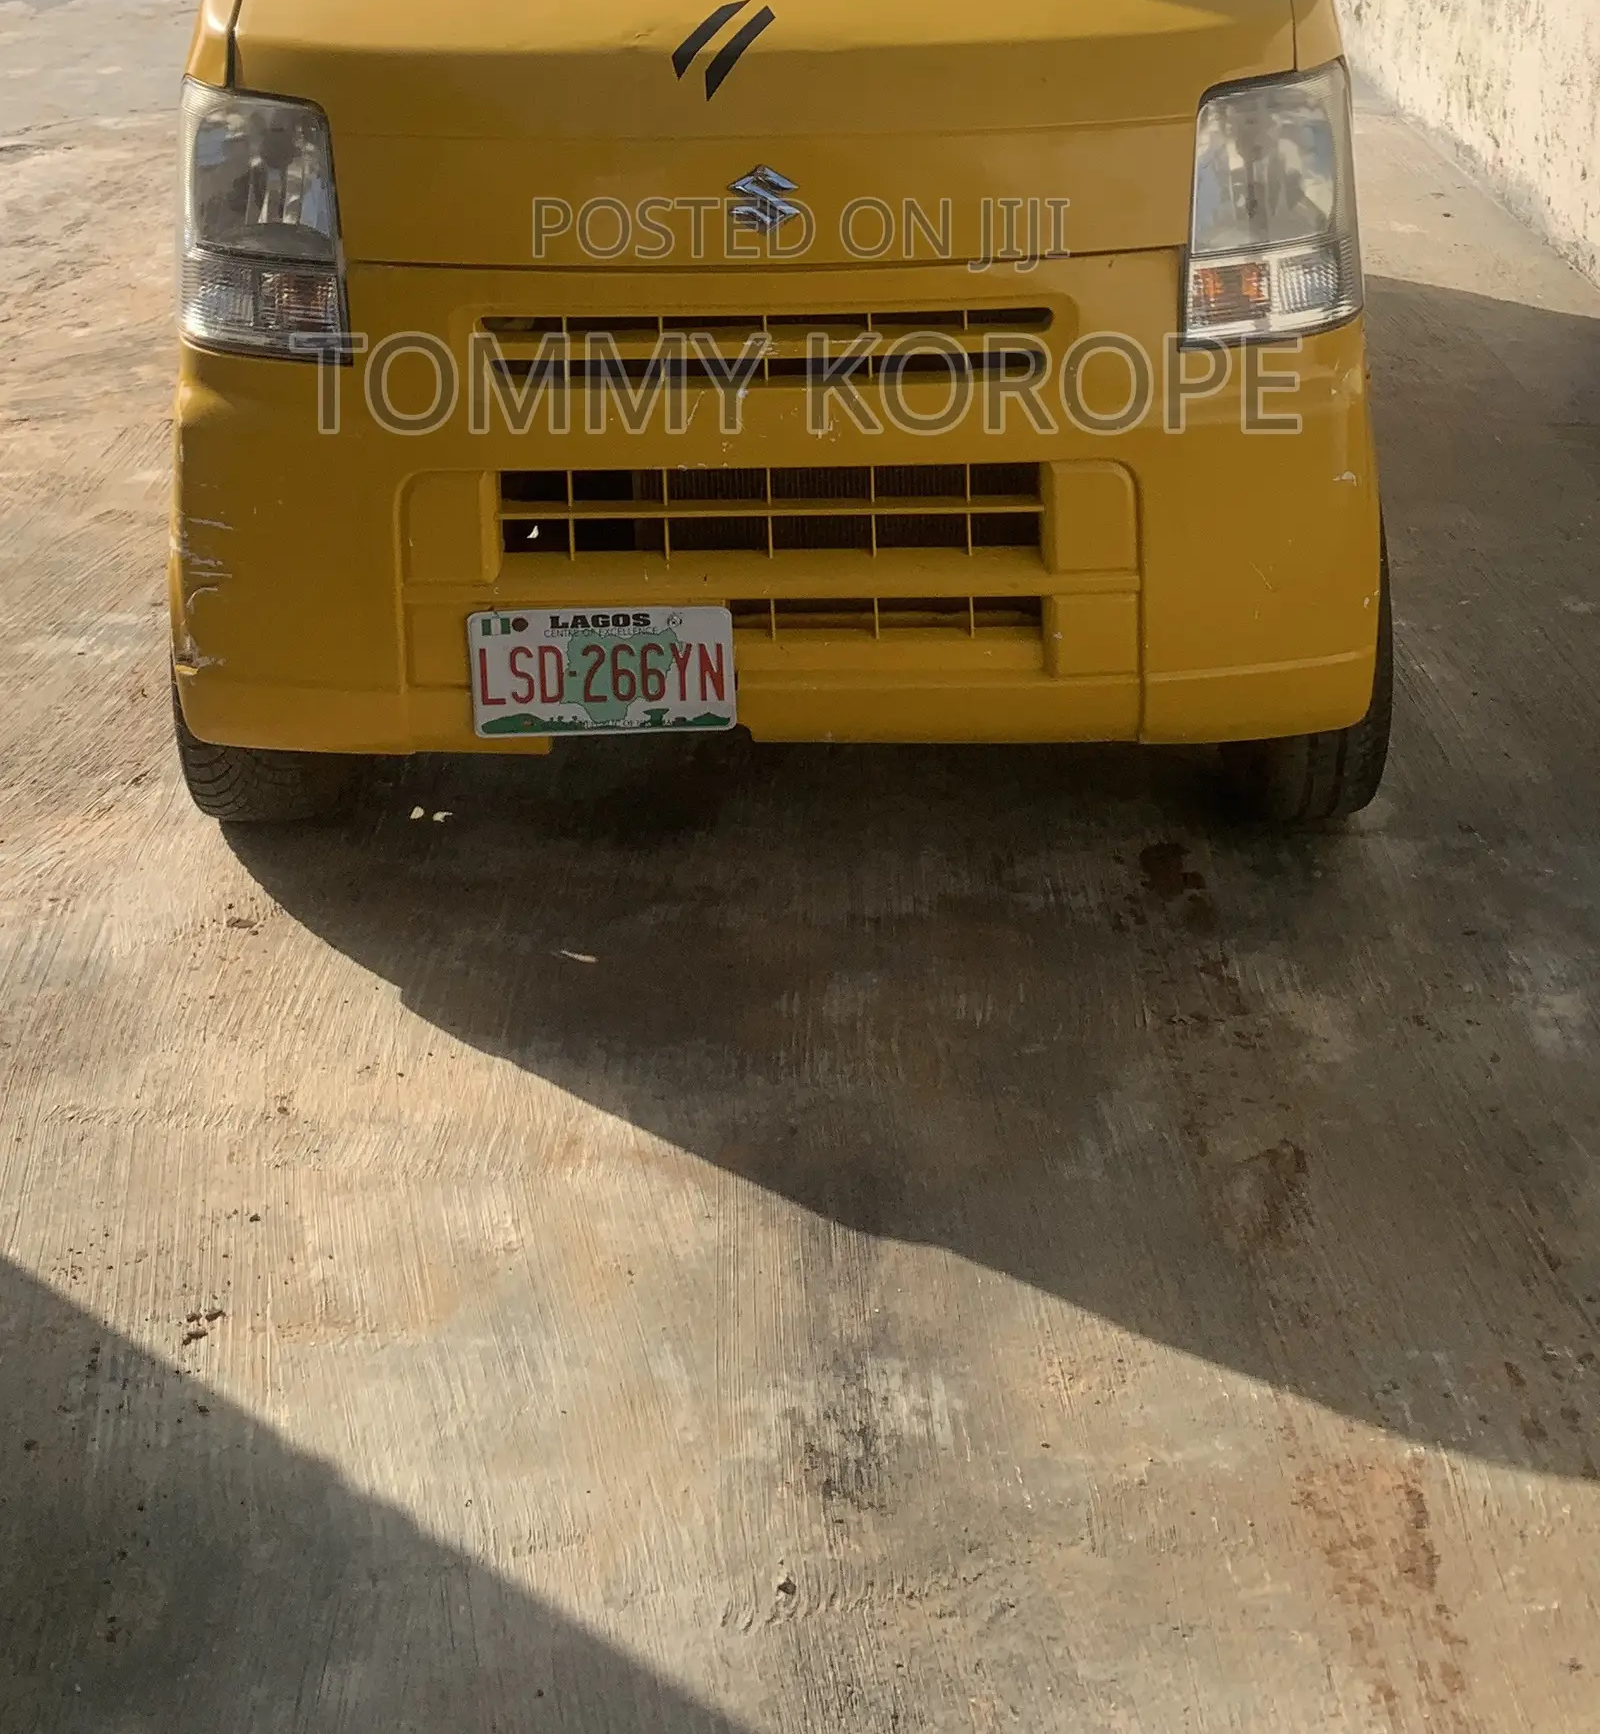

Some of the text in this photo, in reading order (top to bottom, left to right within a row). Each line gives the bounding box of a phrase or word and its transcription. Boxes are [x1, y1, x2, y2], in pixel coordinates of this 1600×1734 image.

[549, 613, 651, 628] LAGOS
[599, 626, 659, 636] EXCELLENCE
[479, 643, 725, 705] LSD-266YN
